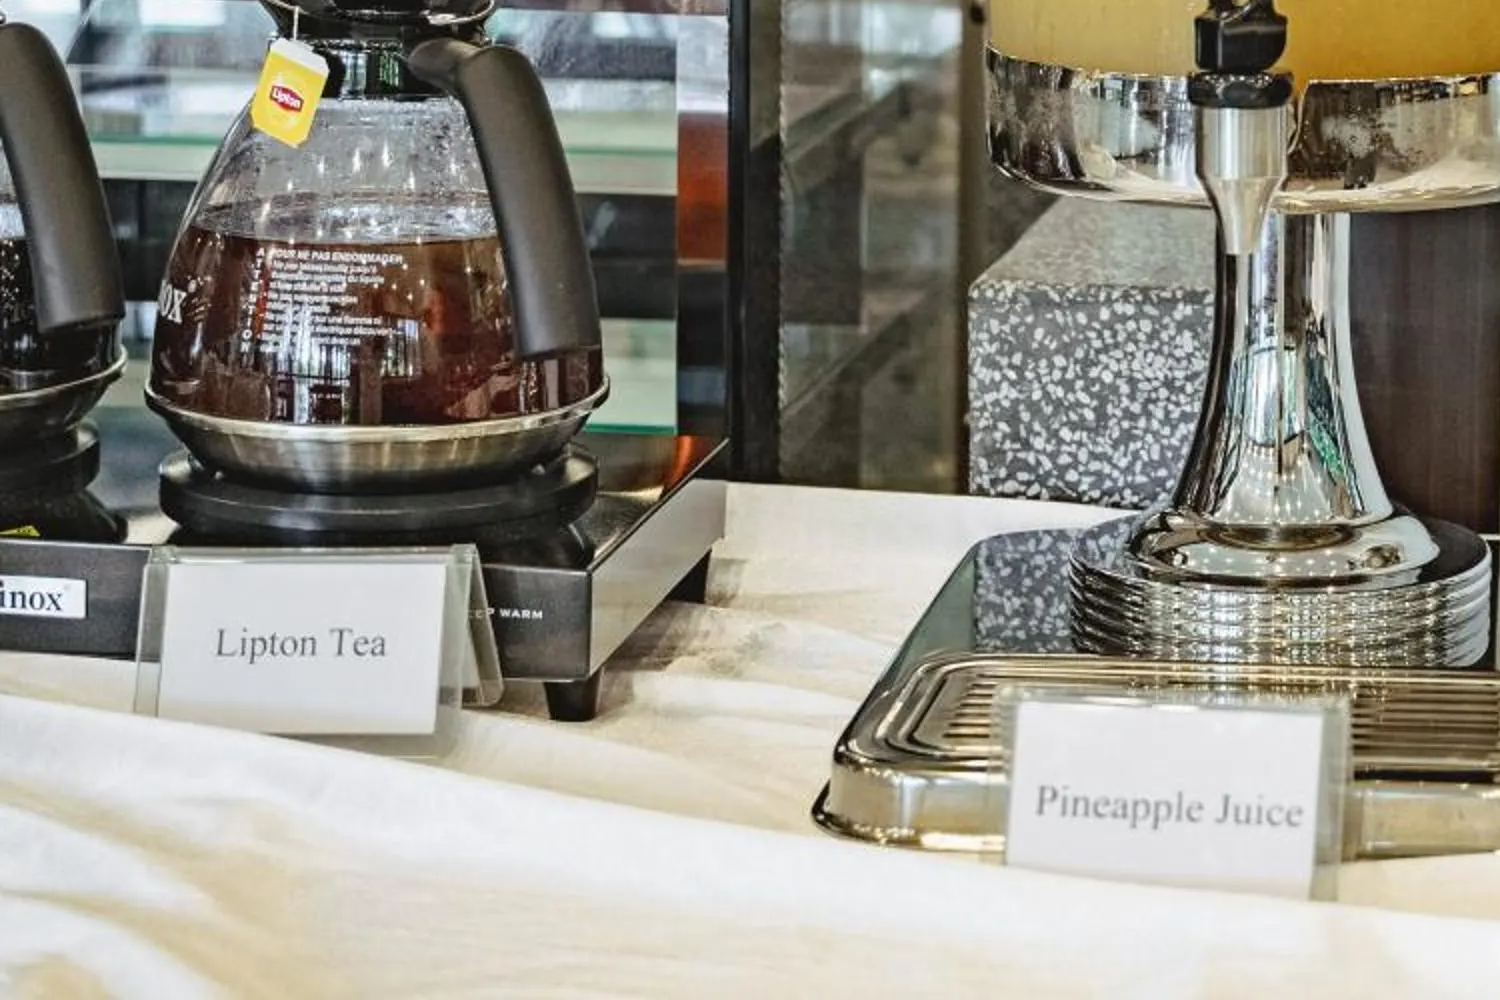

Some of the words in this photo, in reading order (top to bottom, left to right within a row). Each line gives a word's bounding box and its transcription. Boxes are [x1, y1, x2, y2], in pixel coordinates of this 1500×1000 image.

[271, 87, 302, 110] Lipton
[499, 607, 543, 620] WARM
[216, 626, 317, 665] Lipton
[329, 627, 386, 657] Tea
[1036, 785, 1204, 830] Pineapple
[1214, 793, 1304, 827] Juice
